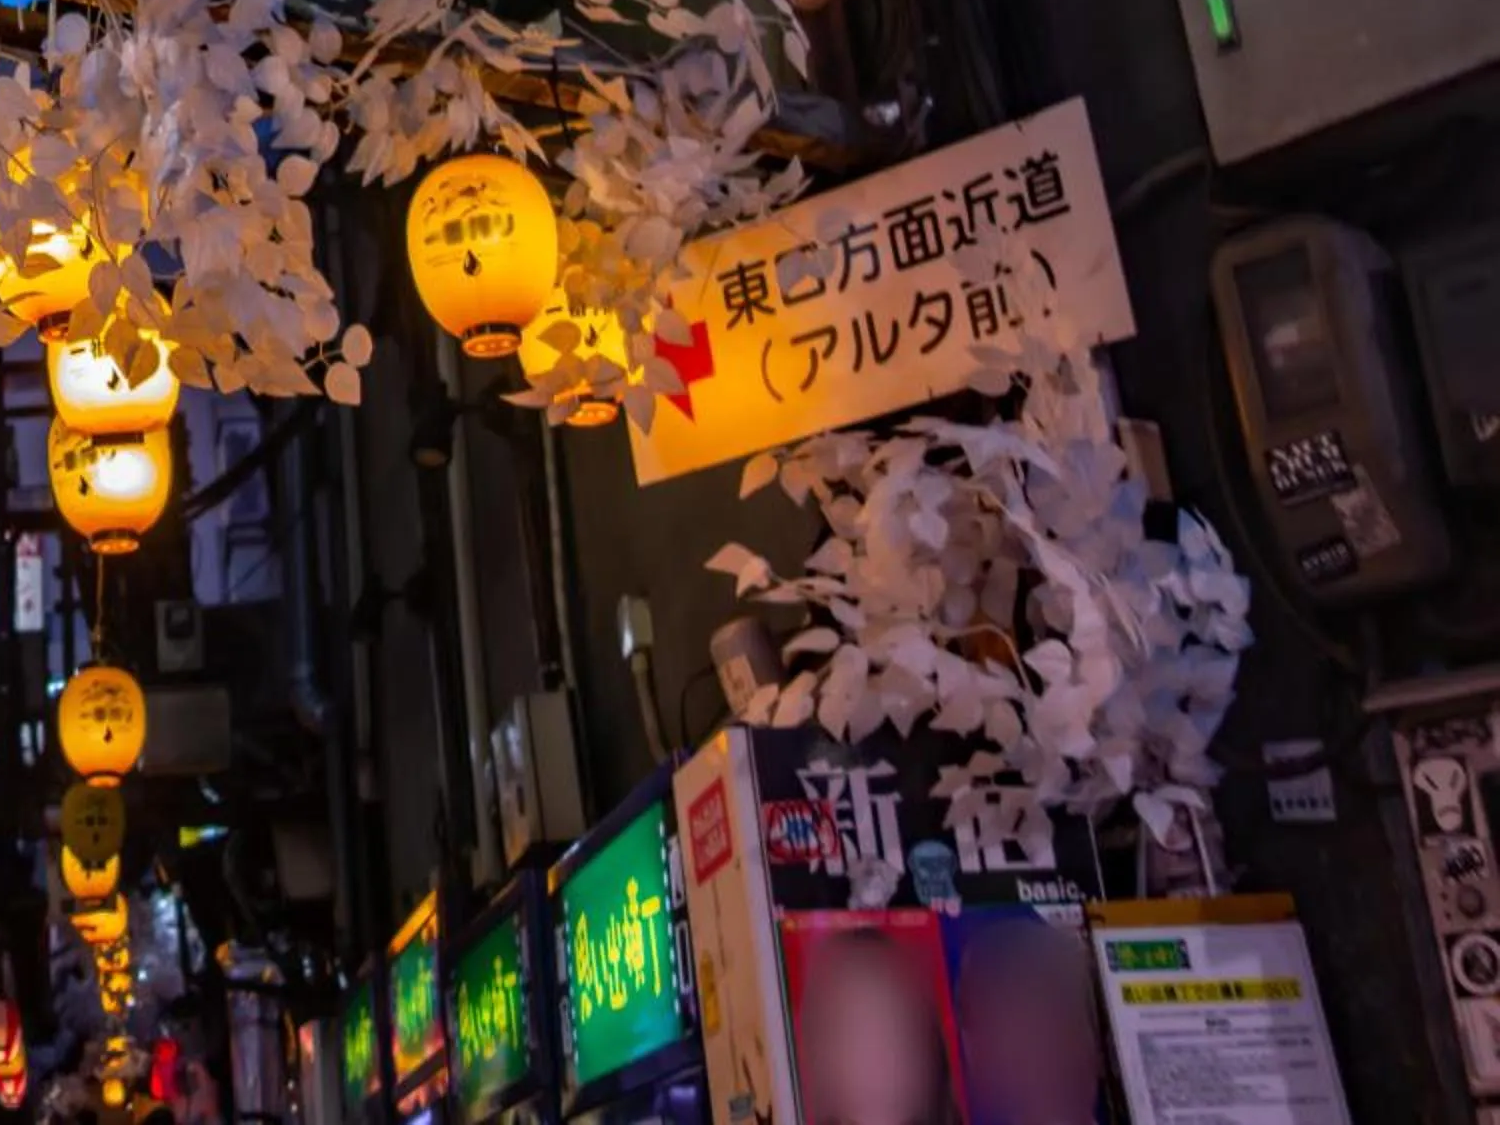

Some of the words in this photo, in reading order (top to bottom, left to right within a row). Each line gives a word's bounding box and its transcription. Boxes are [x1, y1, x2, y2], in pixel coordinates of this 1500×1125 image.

[717, 150, 1071, 330] 東口方面近道
